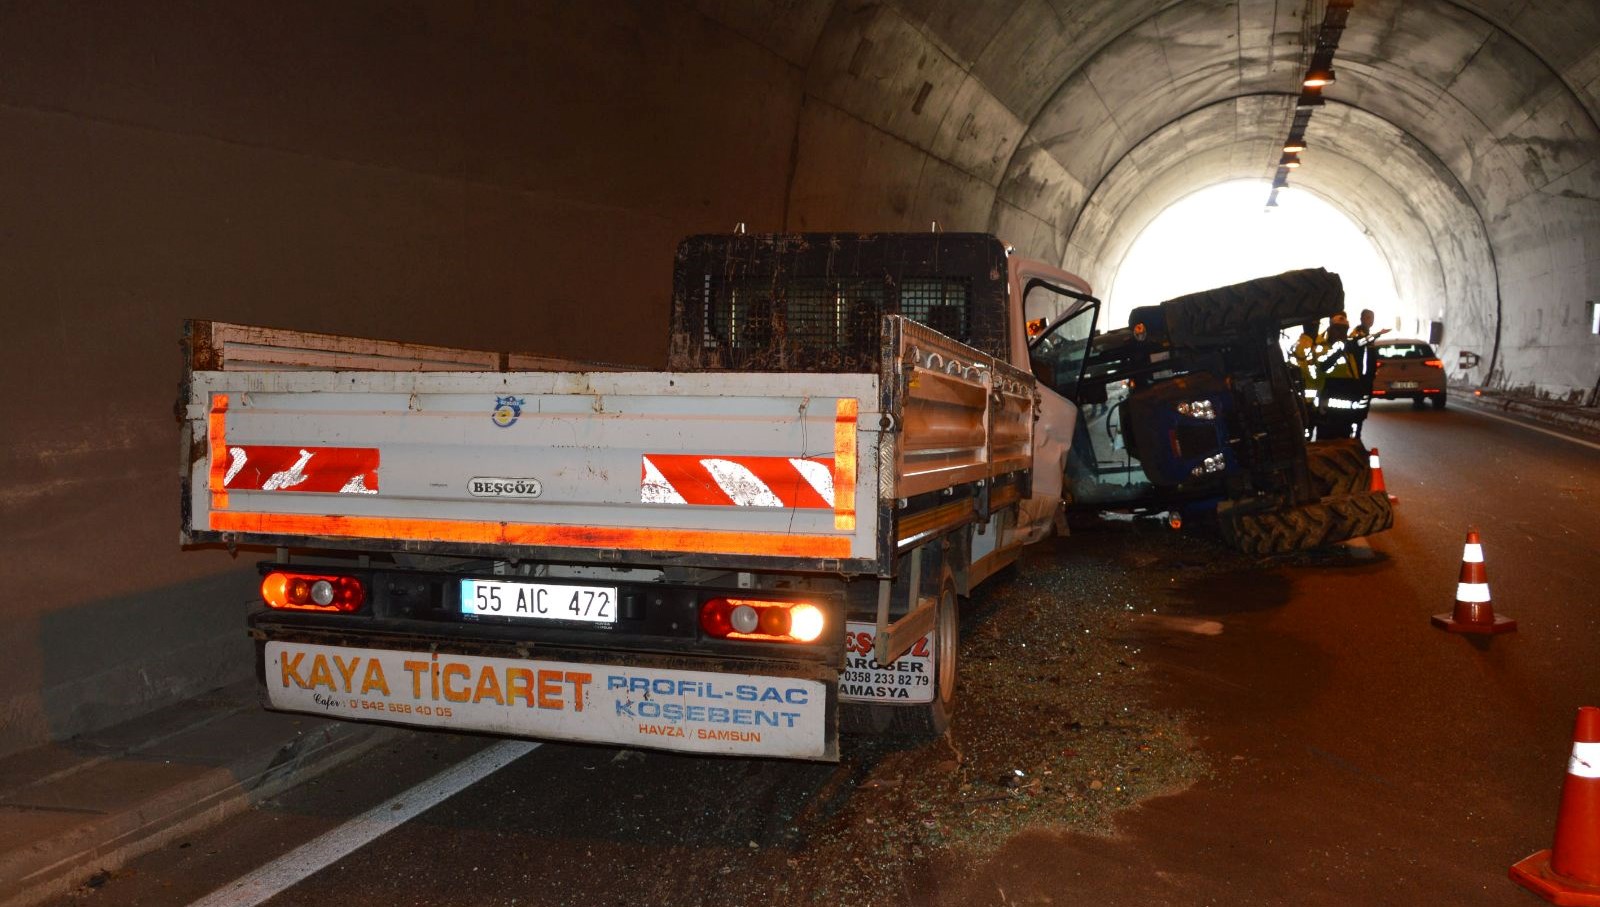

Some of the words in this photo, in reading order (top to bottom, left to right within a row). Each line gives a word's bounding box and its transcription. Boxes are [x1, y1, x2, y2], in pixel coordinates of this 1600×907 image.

[473, 480, 537, 496] BEŞGÖZ
[476, 585, 502, 612] 55
[516, 587, 548, 614] AIC
[568, 590, 610, 618] 472
[280, 651, 390, 697] KAYA
[844, 671, 871, 683] 0358
[874, 673, 895, 684] 233
[898, 674, 912, 686] 82
[915, 675, 929, 686] 79
[839, 683, 909, 698] AMASYA
[313, 693, 341, 710] Cafer
[361, 700, 385, 711] 542
[415, 705, 432, 716] 40
[435, 707, 453, 717] 05
[615, 698, 801, 728] KÖŞEBENT
[639, 723, 685, 738] HAVZA
[697, 728, 762, 743] SAMSUN
